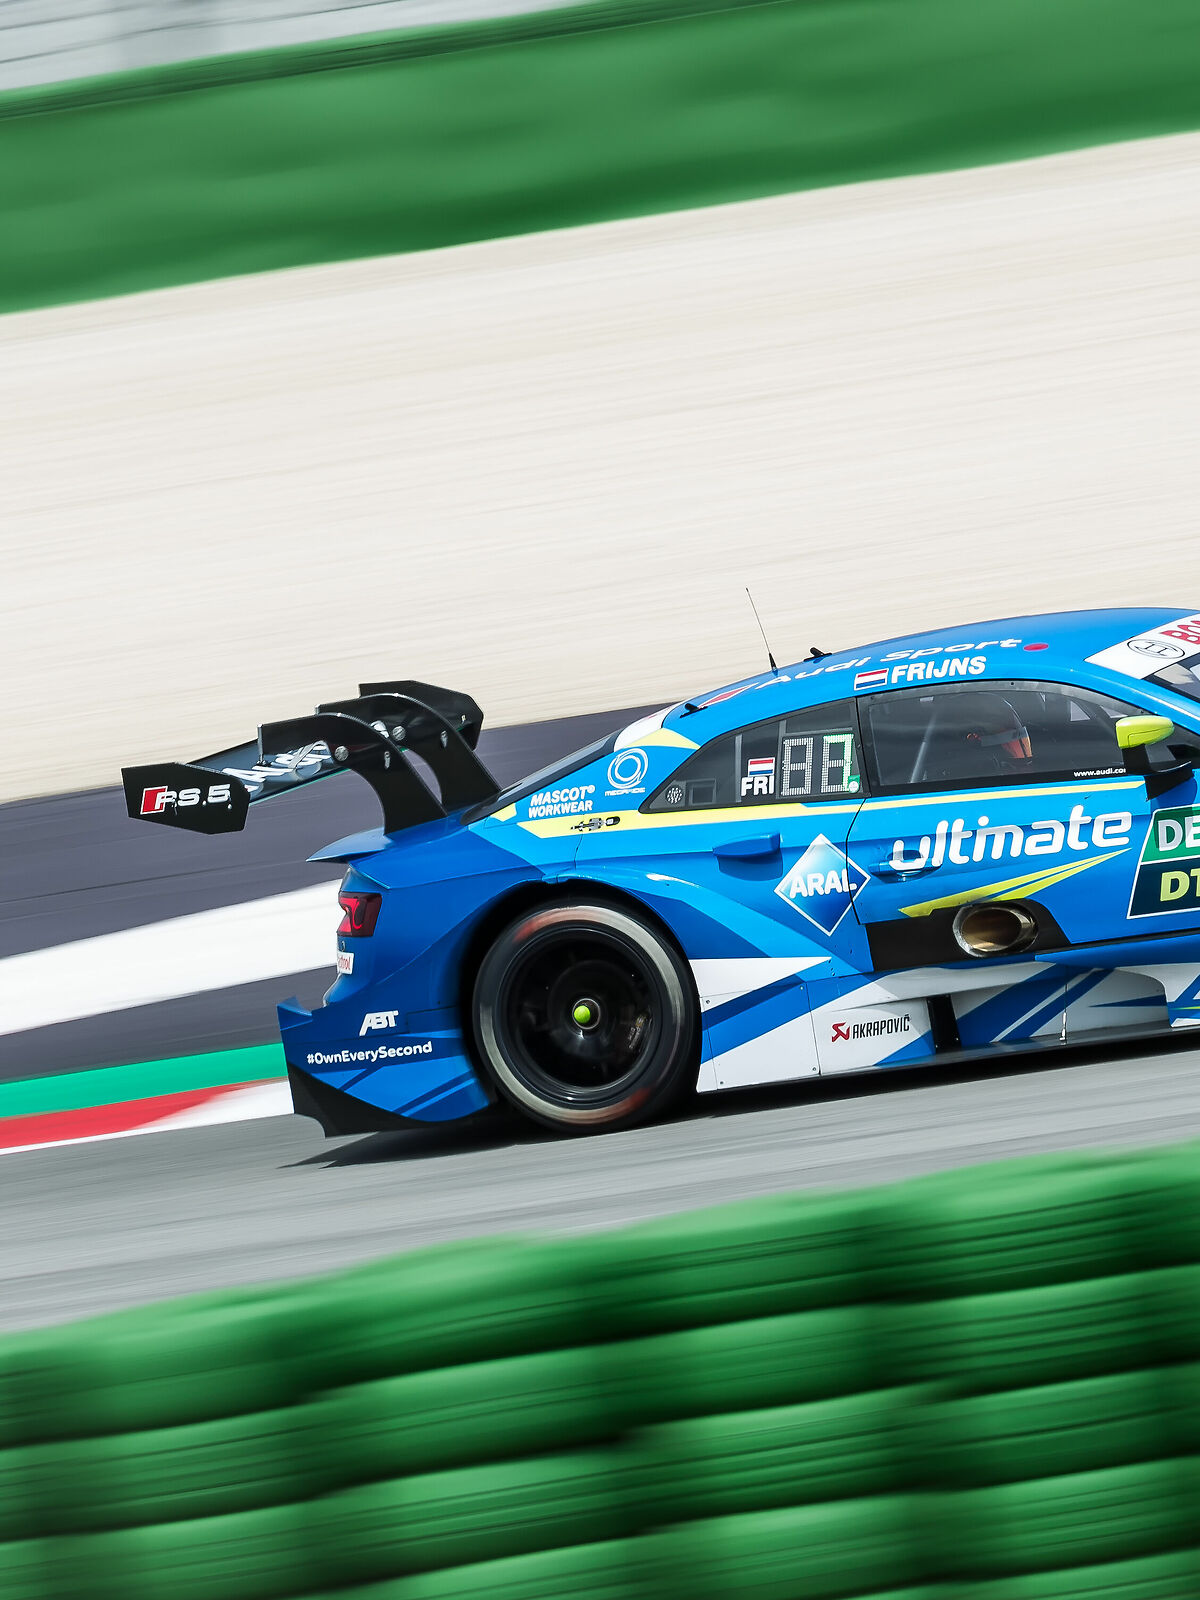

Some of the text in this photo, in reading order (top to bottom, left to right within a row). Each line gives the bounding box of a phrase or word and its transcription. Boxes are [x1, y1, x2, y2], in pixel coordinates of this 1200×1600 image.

[755, 638, 1023, 690] Audi Sport
[891, 656, 987, 684] FRIJNS
[740, 775, 775, 797] FRI
[1073, 767, 1127, 778] www.audi.co
[528, 799, 594, 818] WORKWEAR
[888, 804, 1133, 871] ultimate
[789, 868, 858, 899] ARAL
[358, 1010, 399, 1037] ABT
[852, 1013, 911, 1040] AKRAPOVIČ
[306, 1040, 433, 1065] #OwnEverySecond
